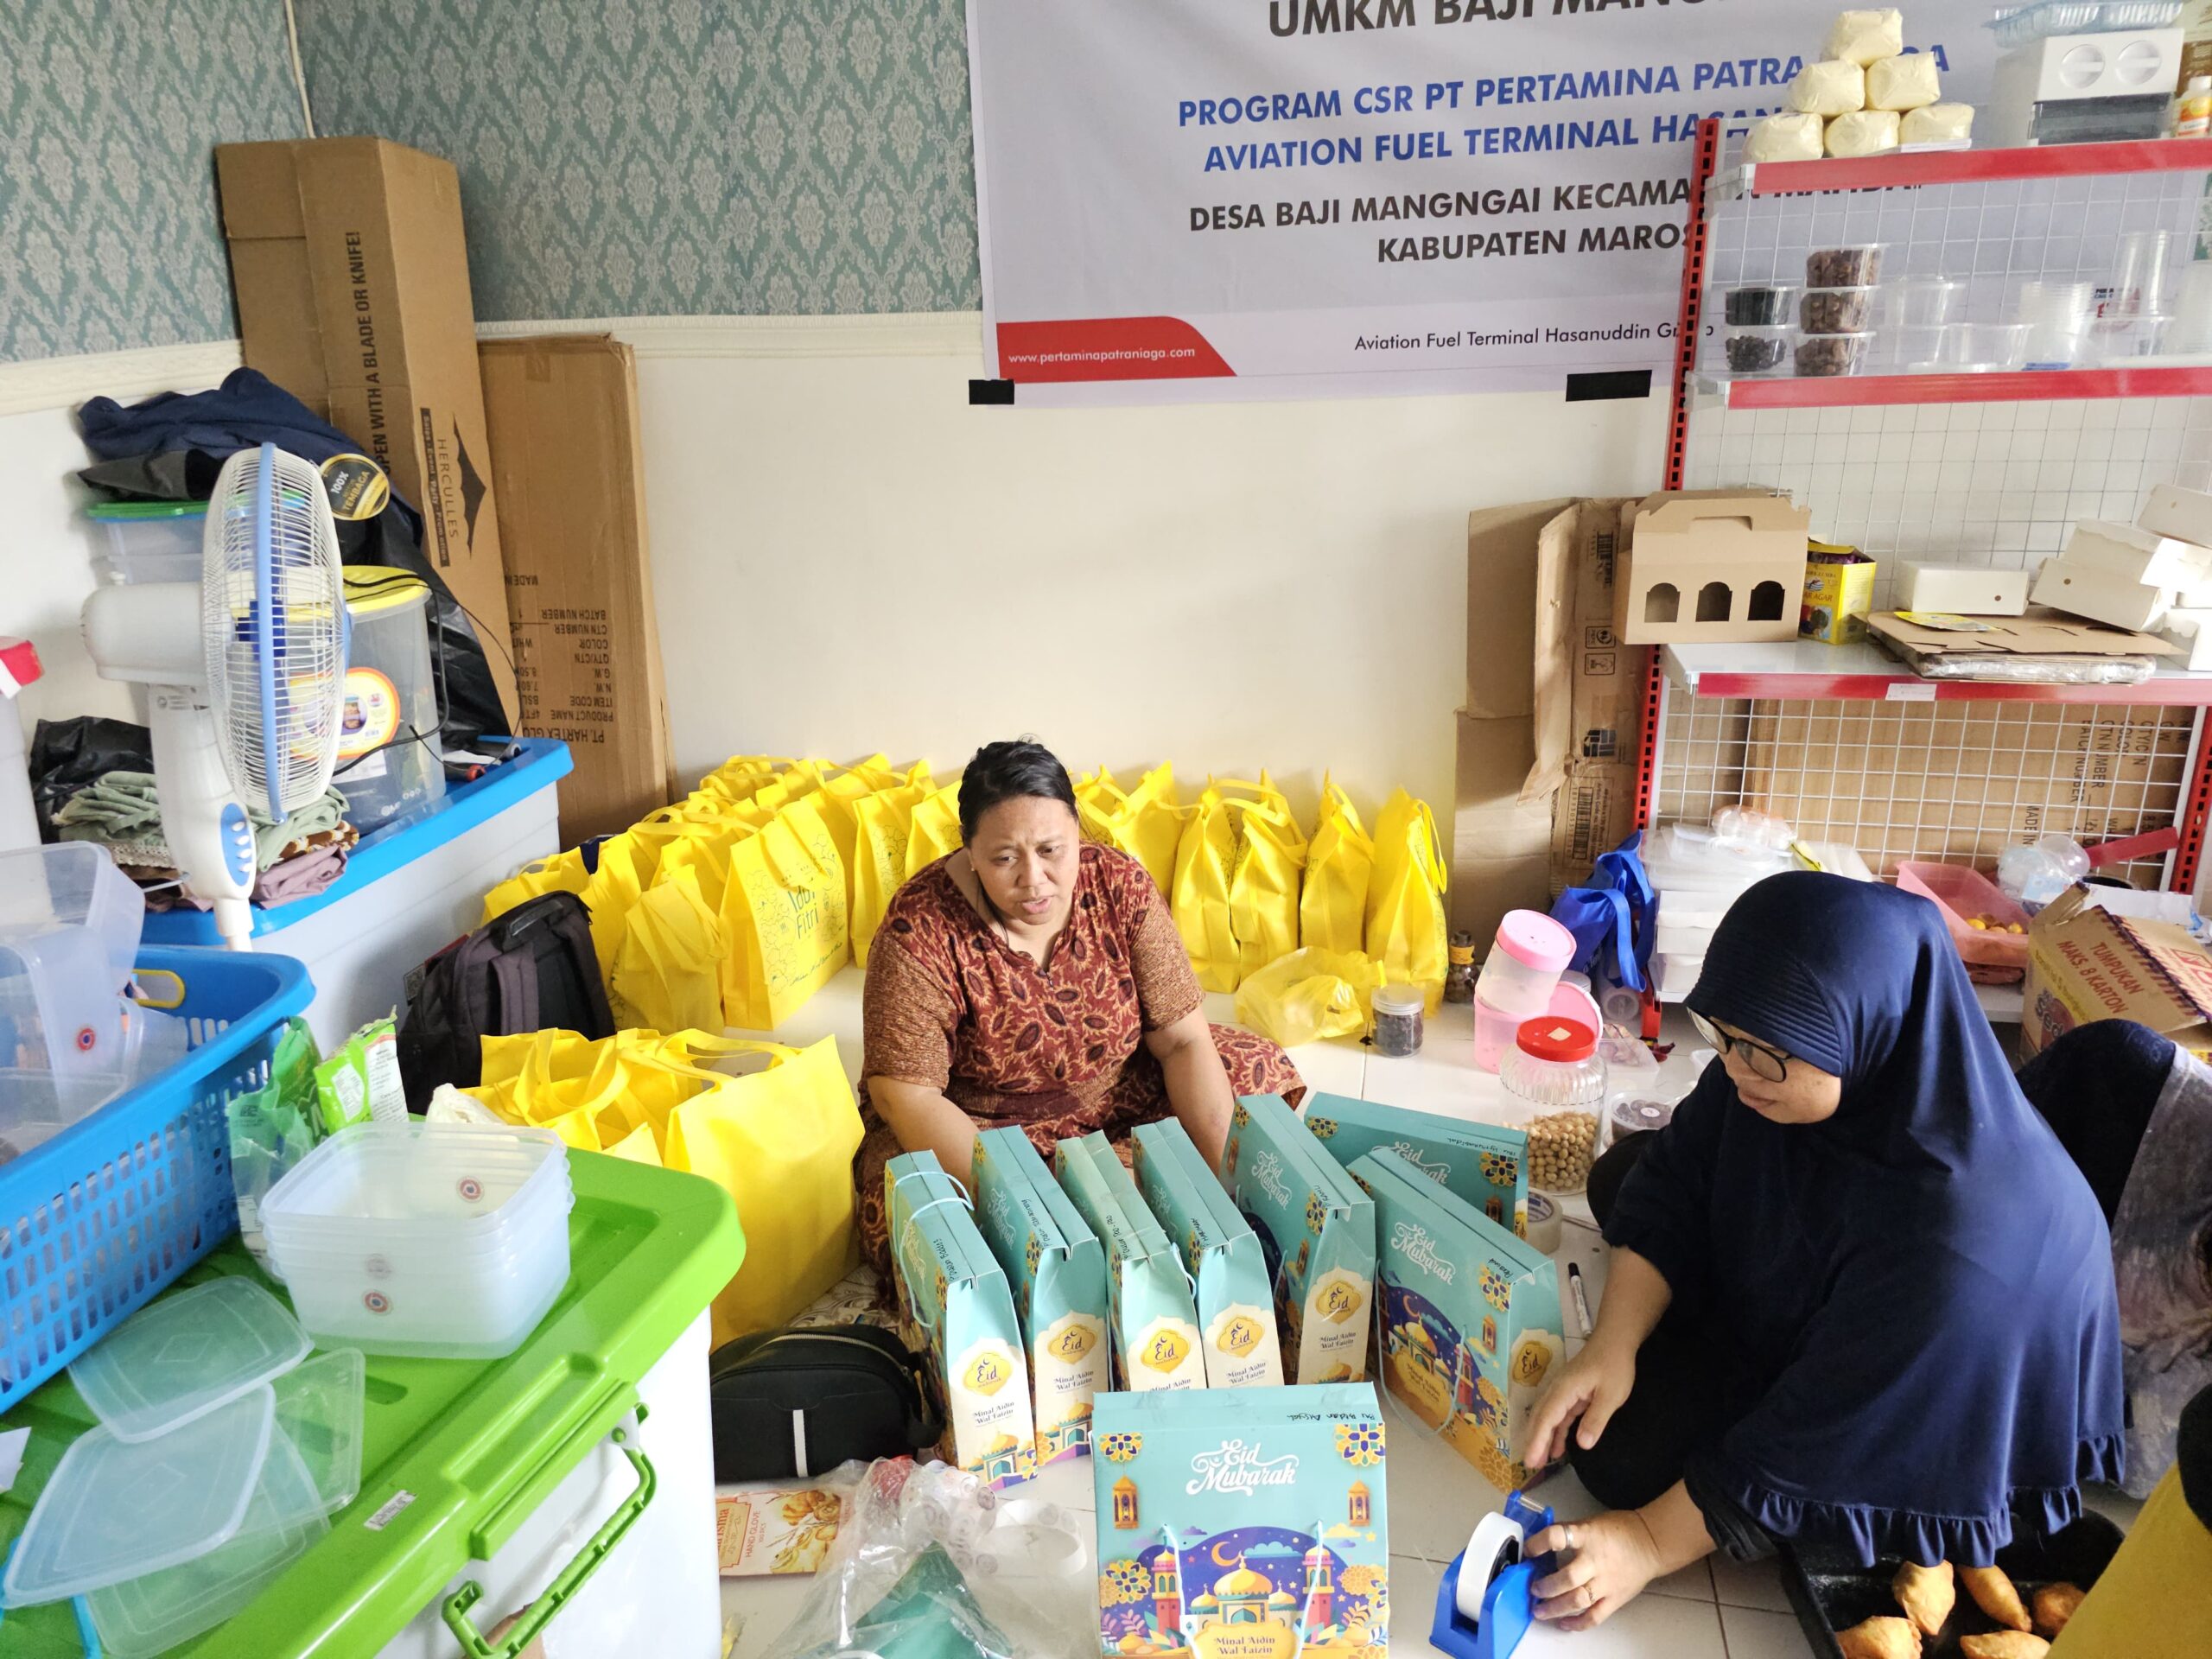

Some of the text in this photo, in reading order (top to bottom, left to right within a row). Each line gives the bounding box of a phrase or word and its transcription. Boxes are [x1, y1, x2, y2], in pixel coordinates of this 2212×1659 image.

[1269, 0, 1416, 37] UMKM
[1179, 55, 1803, 127] PROGRAM CSR PT PERTAMINA PATRA
[1205, 137, 1362, 172] AVIATION
[1376, 131, 1452, 162] FUEL
[1464, 118, 1639, 156] TERMINAL
[1190, 178, 1691, 232] DESA BAJI MANGNGAI KECAMA
[1378, 229, 1567, 263] KABUPATEN
[346, 231, 365, 283] KNIFE!
[353, 289, 370, 311] OR
[357, 315, 378, 368] BLADE
[1354, 334, 1421, 351] Aviation
[1427, 331, 1461, 348] Fuel
[1467, 327, 1539, 346] Terminal
[1546, 323, 1650, 342] Hasanuddin
[1008, 347, 1196, 365] www.pertaminapatraniaga.com
[365, 372, 380, 385] A
[366, 388, 385, 429] WITH
[426, 448, 435, 474] Event
[331, 471, 349, 494] 100%
[342, 471, 371, 511] TEMBAGA
[429, 480, 439, 505] Party
[437, 439, 459, 538] HERCULLES
[513, 575, 538, 586] MADE
[541, 608, 577, 620] NUMBER
[579, 610, 606, 620] BATCH
[554, 623, 607, 634] CTN NUMBER
[512, 638, 608, 649] COLOR WHIT
[594, 683, 612, 693] N.W.
[569, 696, 592, 707] CODE
[594, 697, 613, 708] ITEM
[550, 709, 574, 721] NAME
[576, 710, 613, 721] PRODUCT
[590, 729, 605, 743] PT.
[2157, 721, 2174, 742] GW.
[797, 904, 820, 940] Fitri
[2056, 940, 2088, 969] MAKS.
[2081, 967, 2096, 976] 8
[2090, 941, 2145, 995] TUMPUKAN
[2085, 973, 2129, 1014] KARTON
[1252, 1165, 1290, 1211] Mubarak
[1391, 1236, 1452, 1286] Mubarak
[1053, 1374, 1075, 1383] Minal
[1226, 1368, 1247, 1379] Minal
[1229, 1376, 1244, 1384] Wal
[1057, 1382, 1071, 1390] Wal
[973, 1407, 994, 1418] Minal
[976, 1416, 991, 1425] Wal
[1185, 1462, 1296, 1497] Mubarak
[745, 1510, 760, 1558] HAND GLOVE
[1216, 1636, 1275, 1645] Minal Aidin
[1218, 1646, 1238, 1655] Wal
